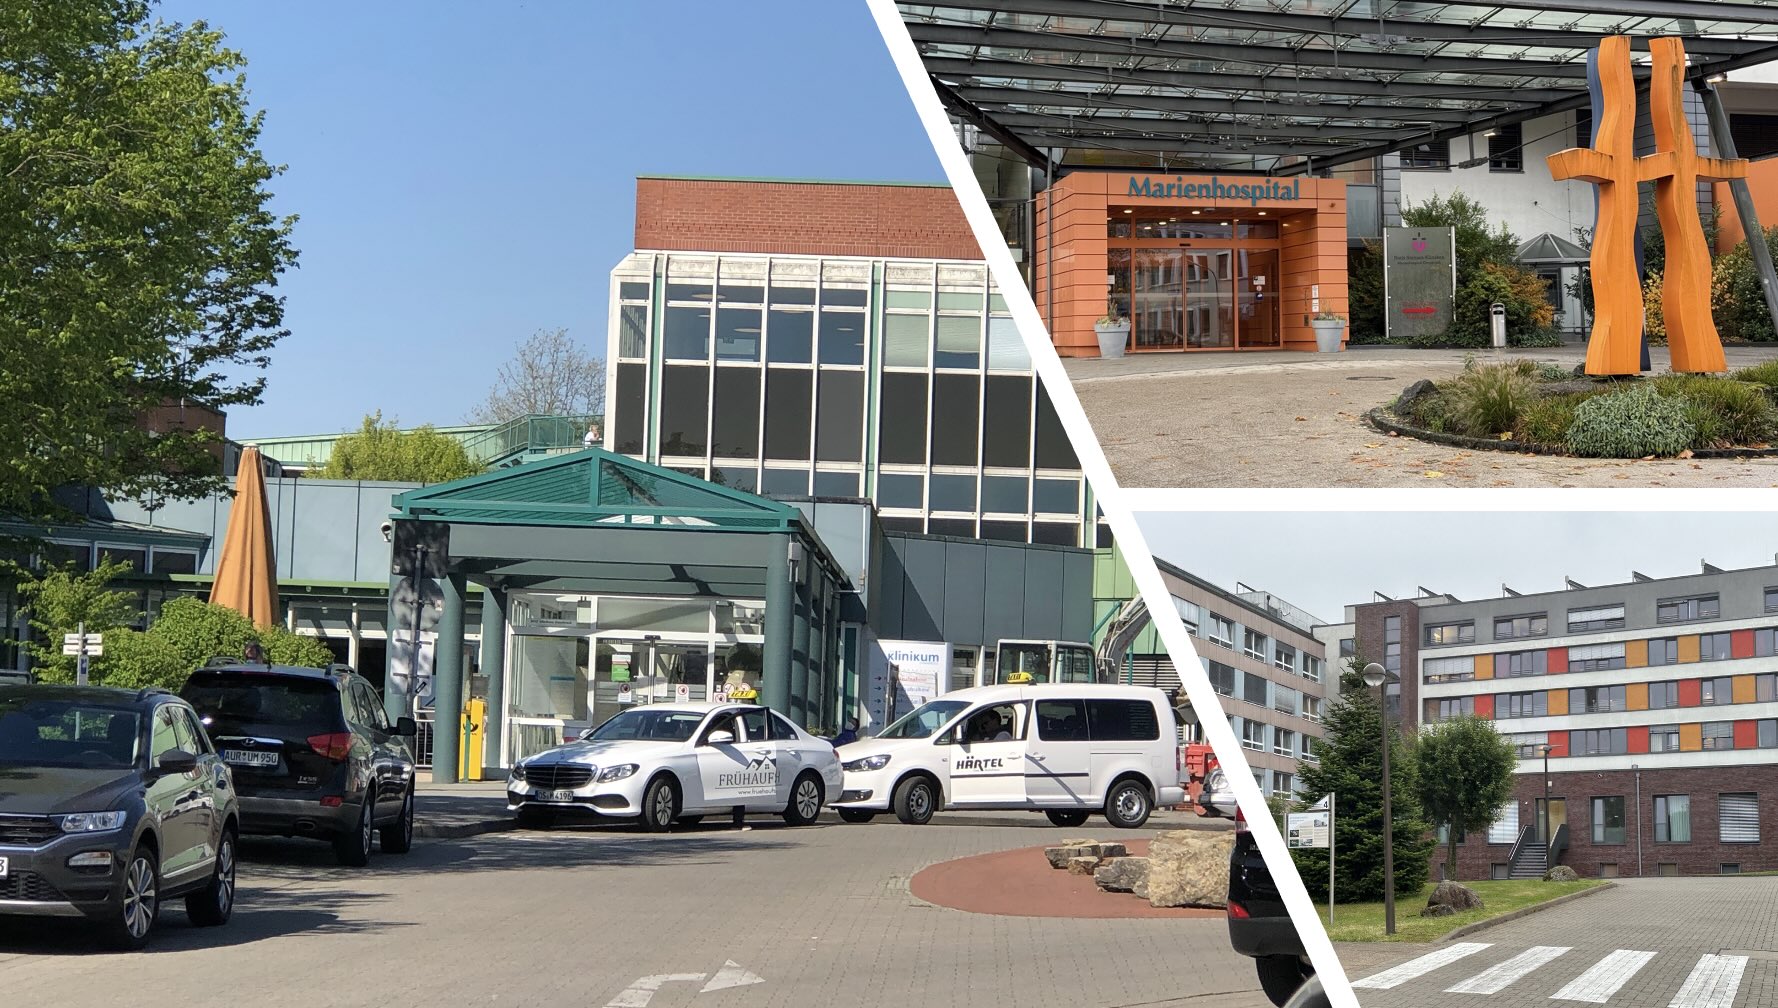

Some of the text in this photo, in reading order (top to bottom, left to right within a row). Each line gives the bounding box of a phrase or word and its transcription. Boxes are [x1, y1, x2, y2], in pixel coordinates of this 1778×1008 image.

[1128, 176, 1299, 207] Marienhospital
[224, 750, 277, 764] AUR UM 950
[956, 755, 1003, 771] HÄRTEL
[554, 792, 573, 801] 4196
